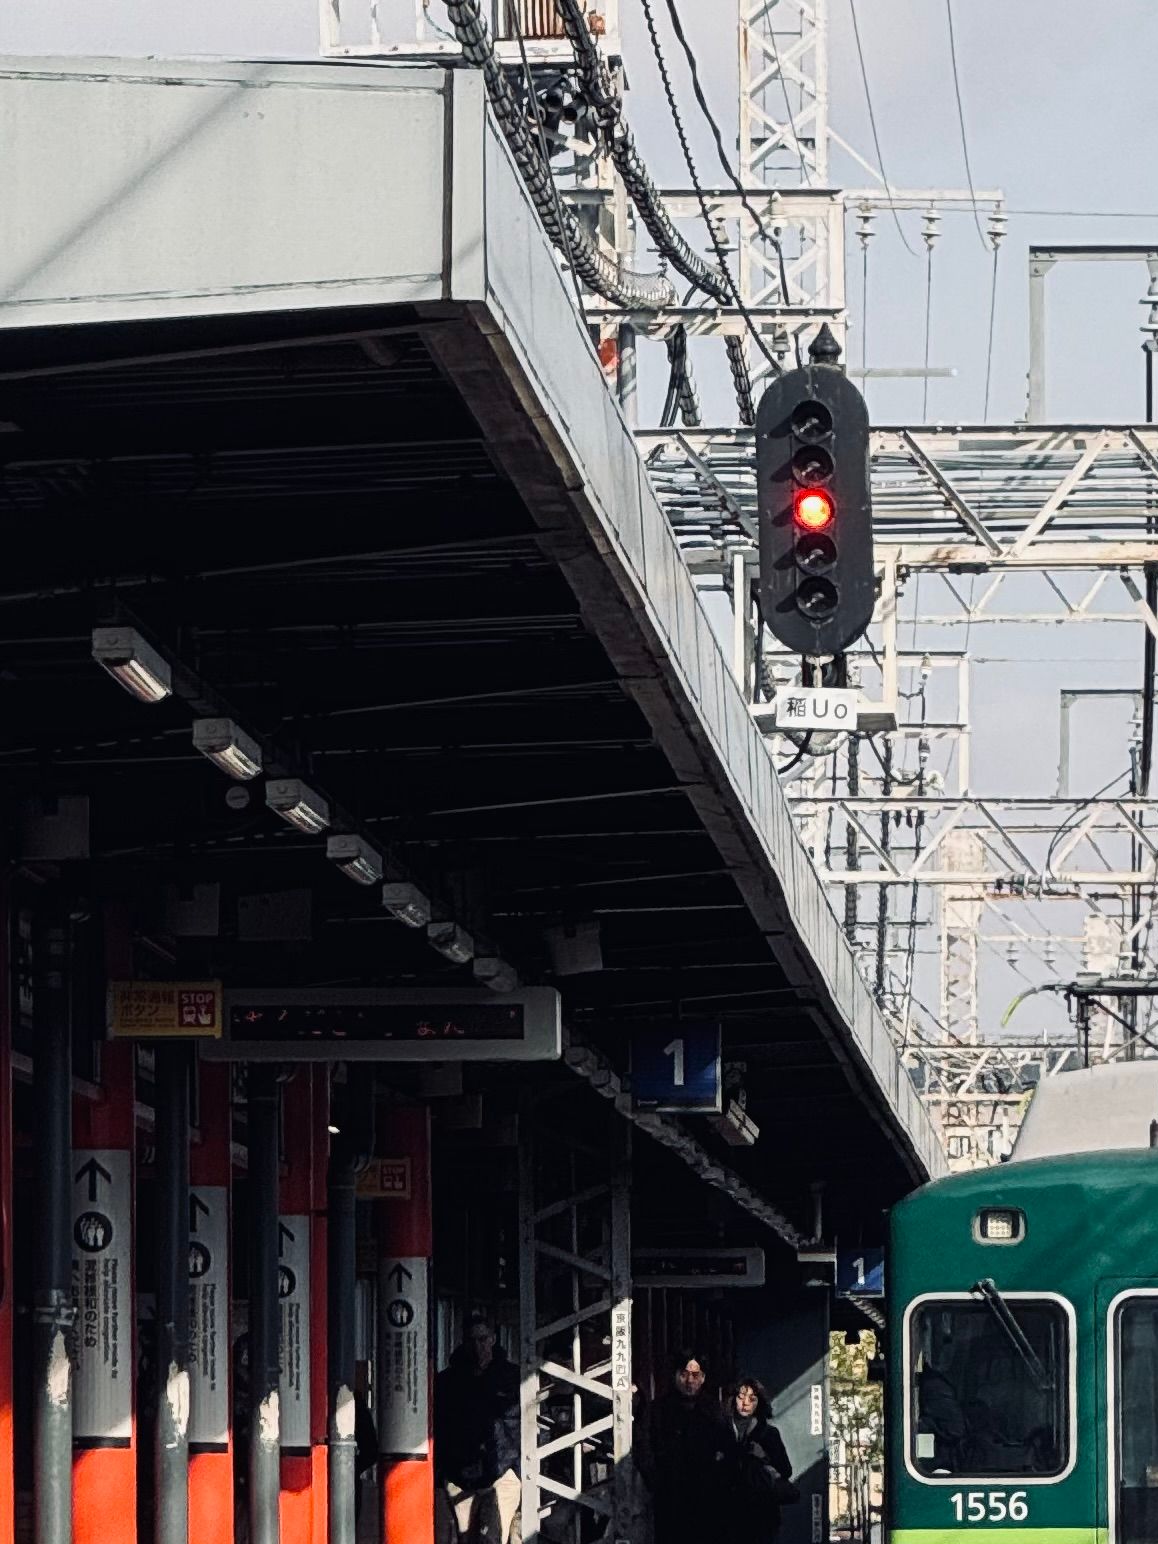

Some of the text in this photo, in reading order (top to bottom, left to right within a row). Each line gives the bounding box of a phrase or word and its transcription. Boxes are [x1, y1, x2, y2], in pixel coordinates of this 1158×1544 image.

[181, 993, 213, 1004] STOP
[663, 1039, 685, 1086] 1
[852, 1257, 866, 1286] 1
[950, 1491, 1028, 1521] 1556
